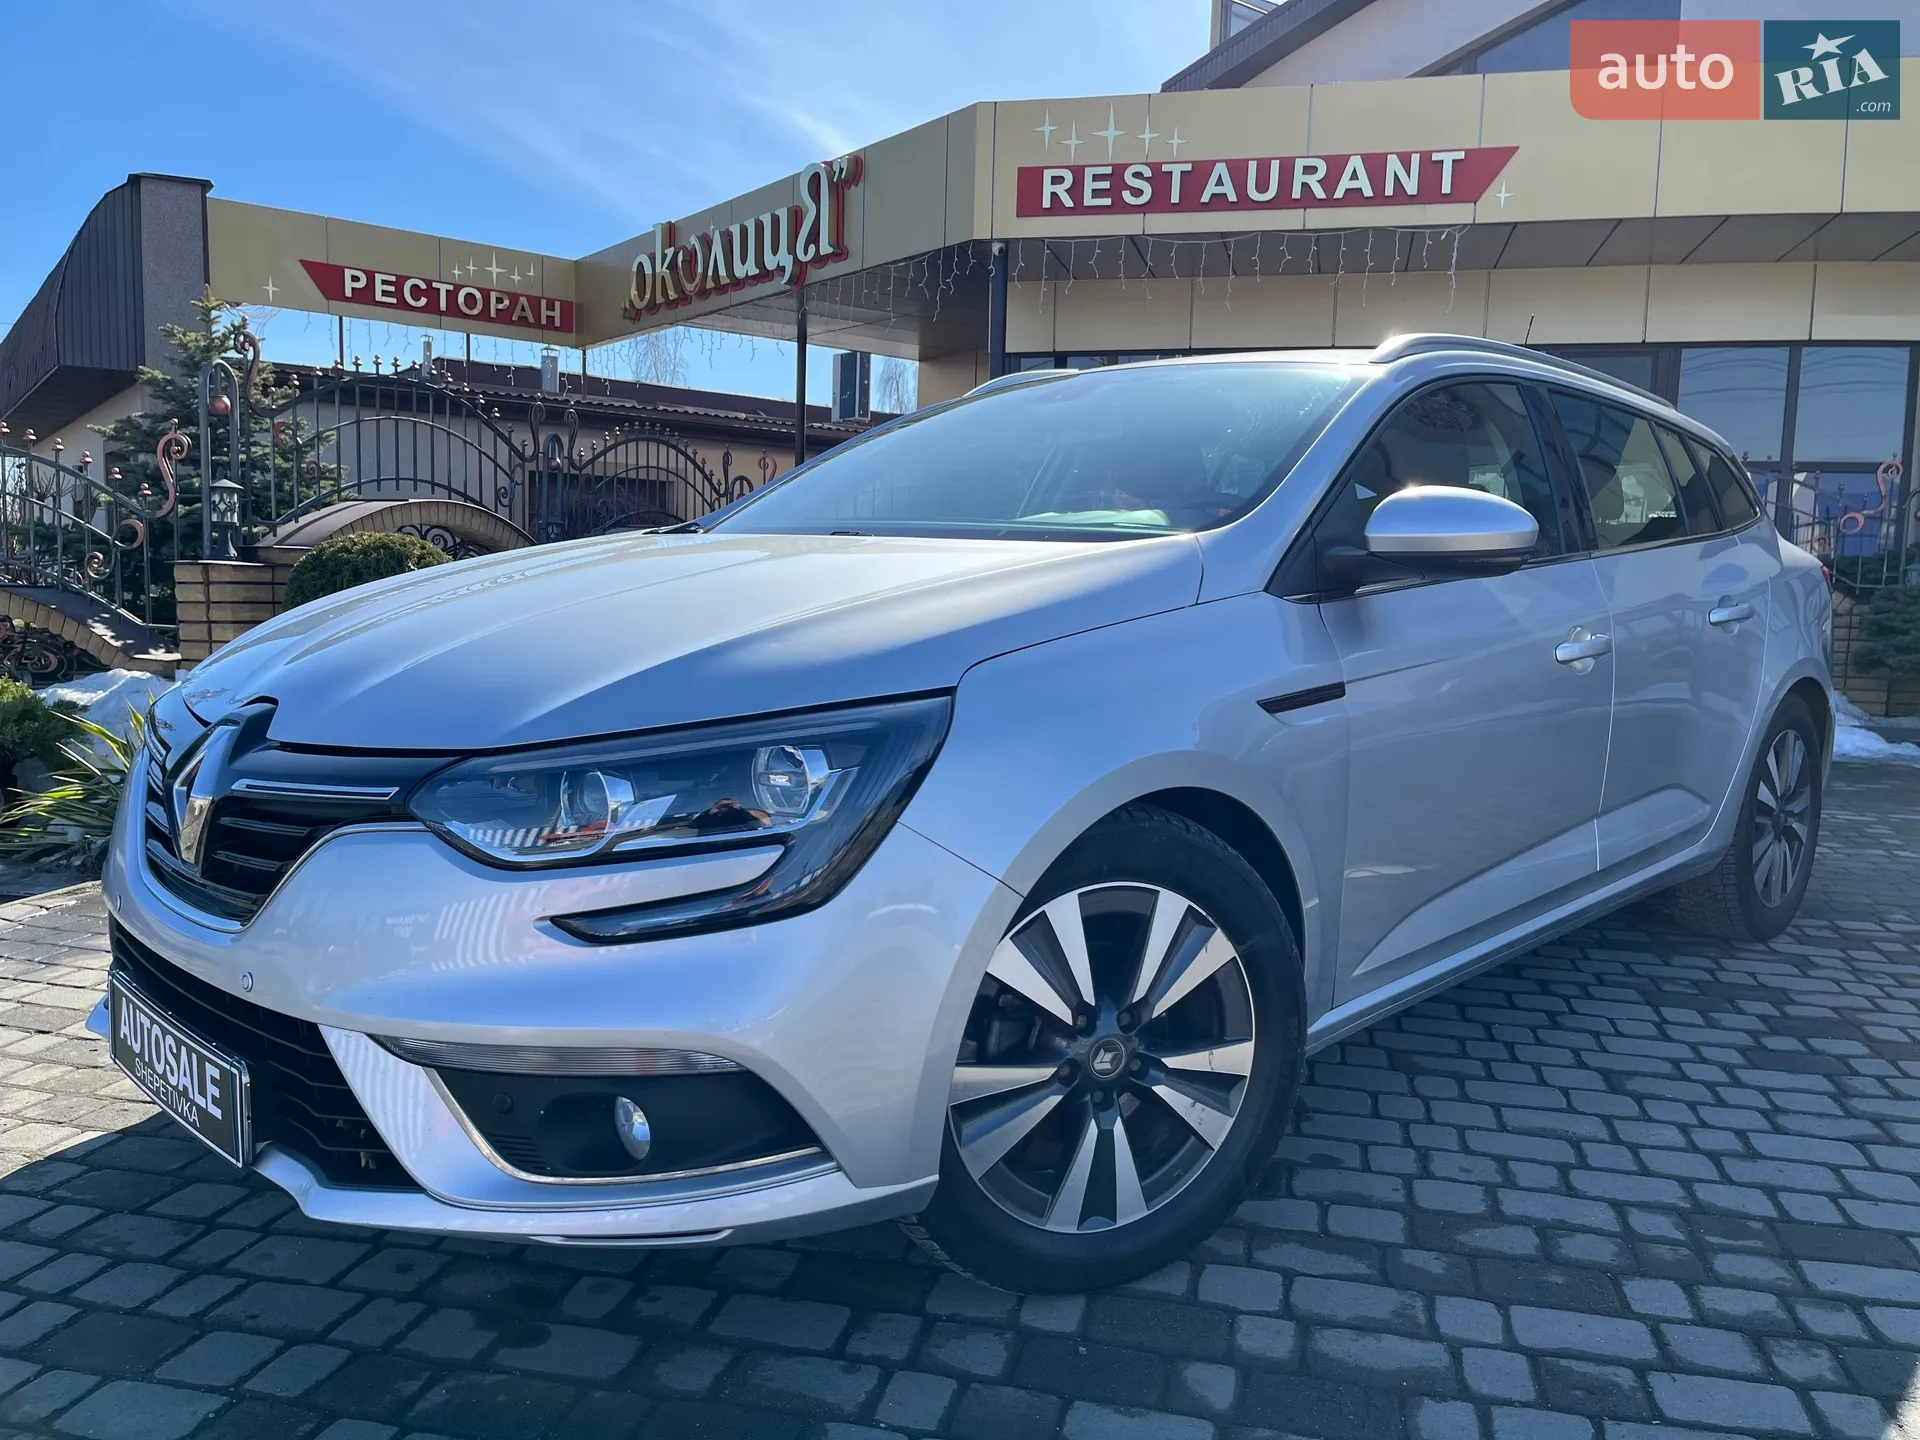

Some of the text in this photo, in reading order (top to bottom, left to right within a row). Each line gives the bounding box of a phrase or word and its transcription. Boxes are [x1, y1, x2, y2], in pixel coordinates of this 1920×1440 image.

[1041, 151, 1465, 208] RESTAURANT
[343, 268, 561, 327] РЕСТОРАН
[120, 996, 222, 1120] AUTOSALE
[135, 1057, 200, 1128] SHEPETIVKA
